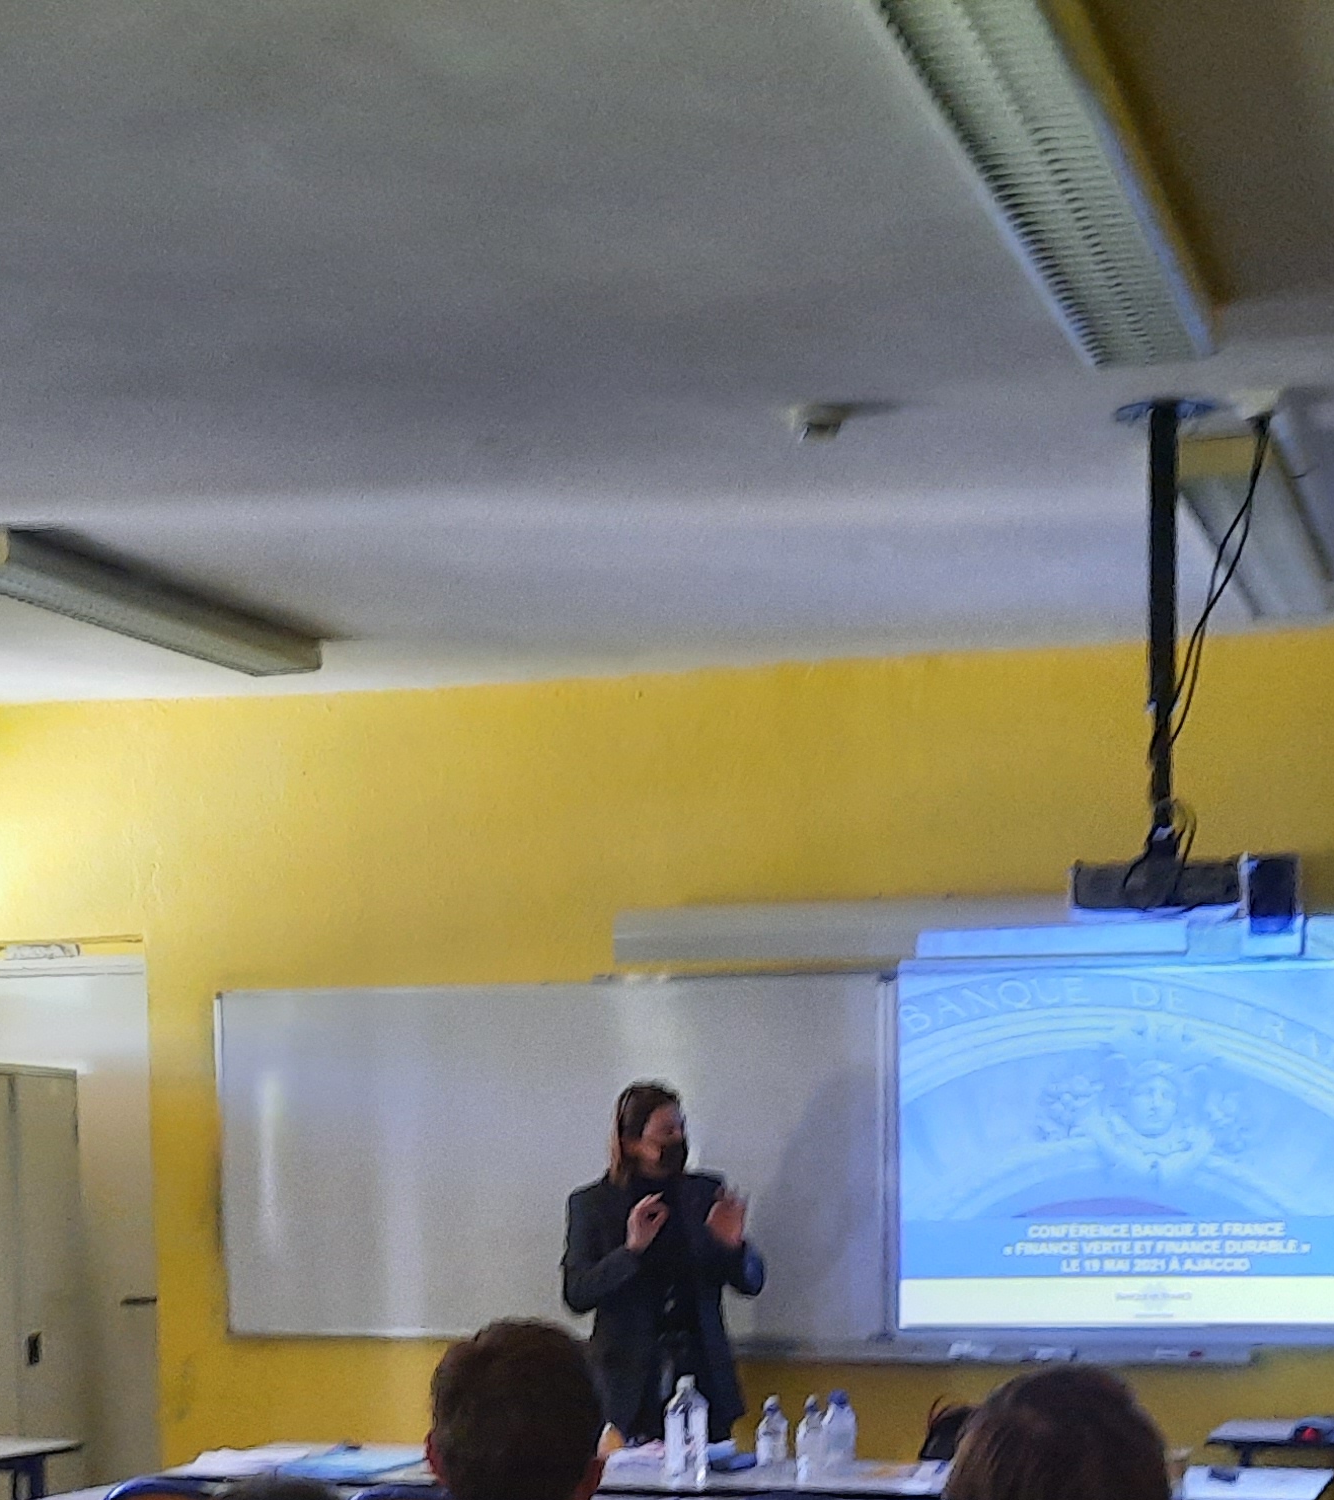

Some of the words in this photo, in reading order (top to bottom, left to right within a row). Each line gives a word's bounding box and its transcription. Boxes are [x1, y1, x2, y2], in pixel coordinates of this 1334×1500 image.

[901, 977, 1090, 1034] BANQUE
[1131, 980, 1189, 1013] DE
[1132, 1222, 1196, 1237] BANQUE
[1198, 1222, 1220, 1236] DE
[1222, 1220, 1286, 1236] FRANCE
[1014, 1241, 1079, 1256] FINANCE
[1082, 1240, 1132, 1255] VERTE
[1133, 1240, 1154, 1255] ET
[1155, 1239, 1222, 1255] FINANCE
[1224, 1239, 1298, 1254] DURABLE
[1060, 1257, 1080, 1273] LE
[1084, 1257, 1101, 1272] 19
[1103, 1257, 1130, 1272] MAI
[1182, 1257, 1251, 1272] AJACCIO
